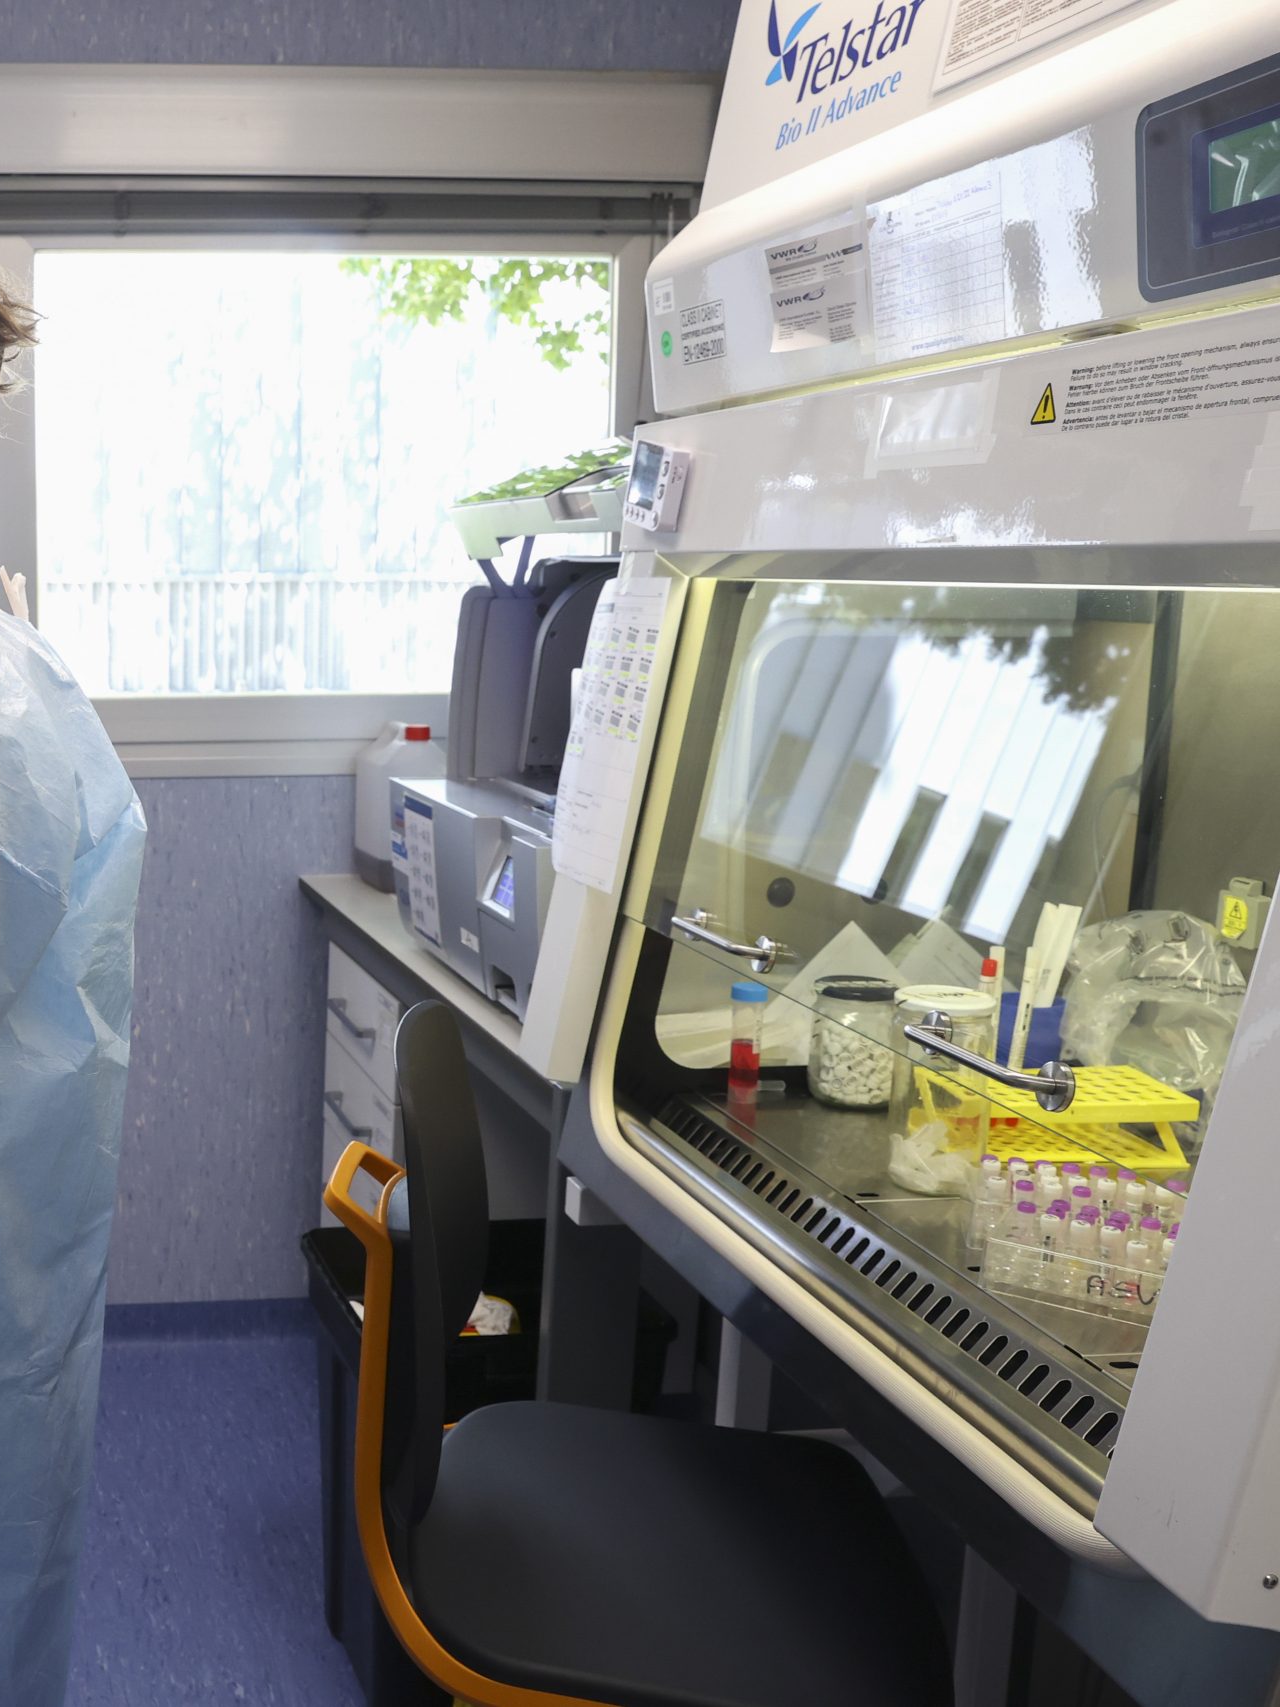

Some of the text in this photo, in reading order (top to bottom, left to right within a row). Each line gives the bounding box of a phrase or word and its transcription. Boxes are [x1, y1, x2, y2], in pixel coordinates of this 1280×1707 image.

[796, 0, 925, 103] Telstar
[776, 71, 902, 151] Bio II Advance
[776, 296, 802, 307] VWR
